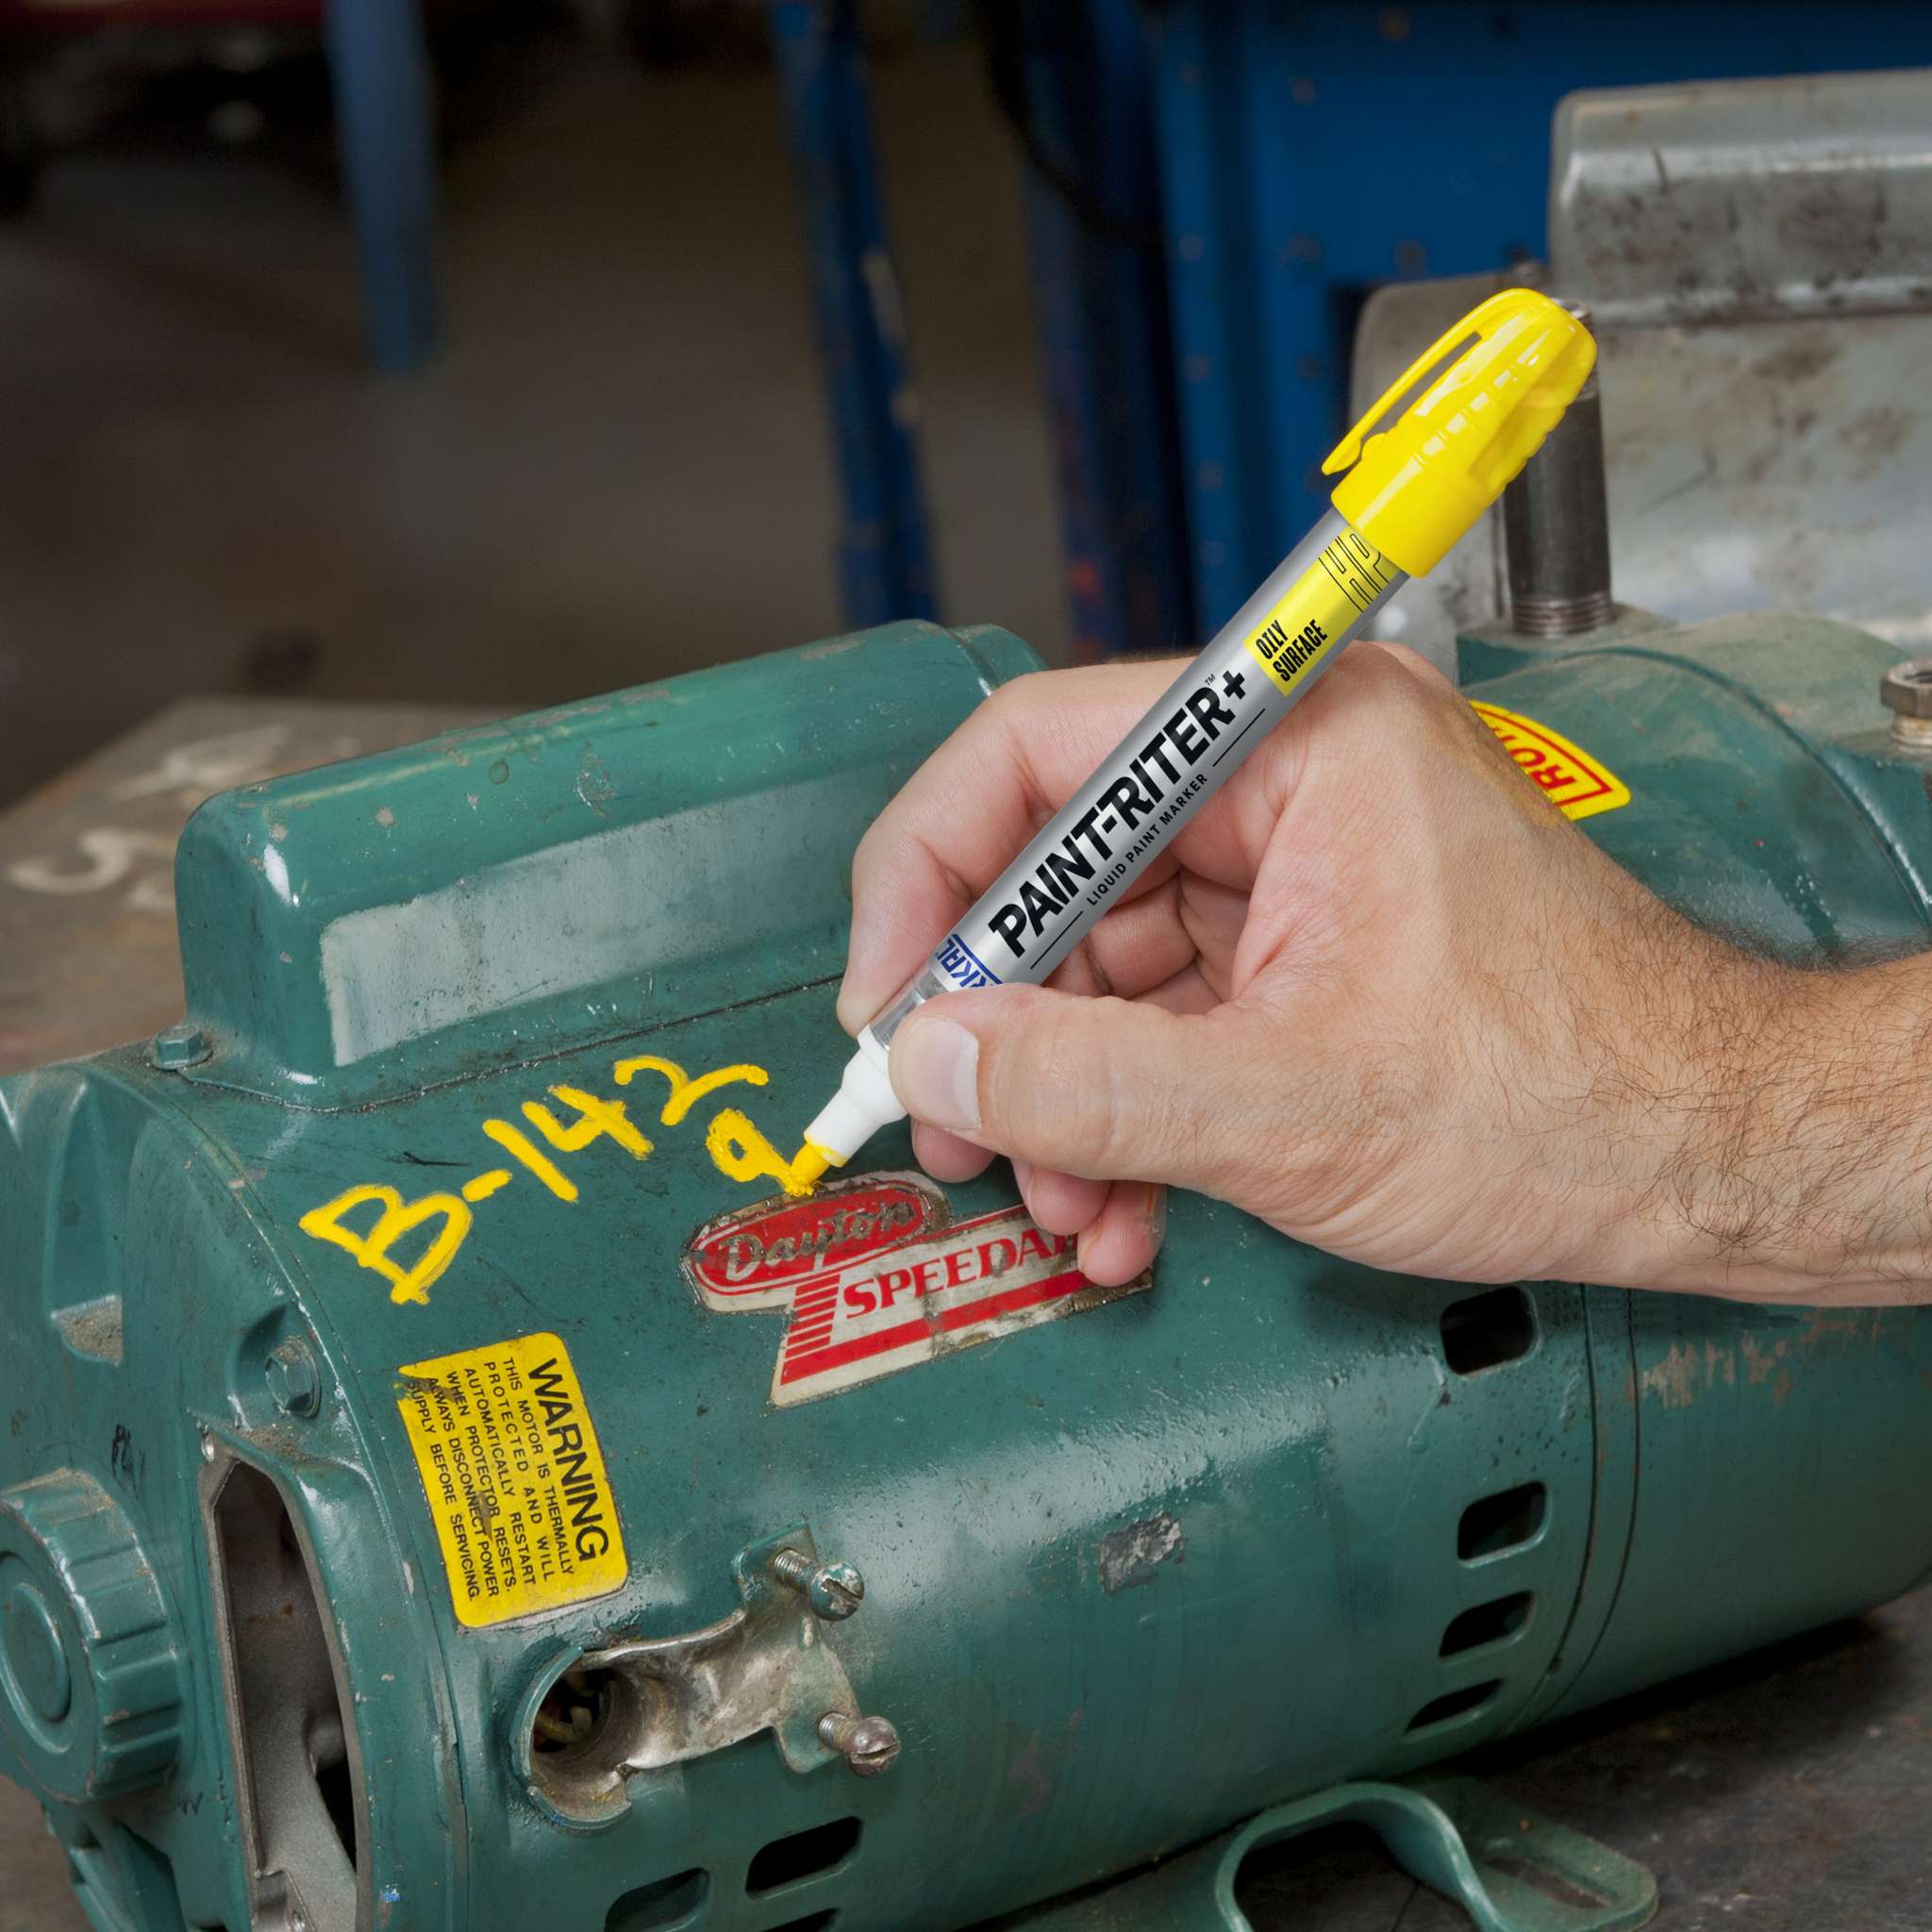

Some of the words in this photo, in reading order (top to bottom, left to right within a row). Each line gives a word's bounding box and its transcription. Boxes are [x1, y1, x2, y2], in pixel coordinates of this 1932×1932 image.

[1256, 620, 1289, 660] OILY
[1274, 619, 1328, 682] SURFACE
[1087, 862, 1127, 906] LIQUID
[1125, 826, 1161, 864] PAINT
[1159, 773, 1208, 826] MARKER
[299, 1055, 769, 1305] B-142
[718, 1200, 915, 1281] Dayton
[503, 1357, 523, 1391] THIS
[517, 1400, 543, 1455] MOTOR
[407, 1383, 437, 1434] SUPPLY
[430, 1443, 457, 1505] BEFORE
[450, 1513, 481, 1602] SERVICING.
[428, 1377, 456, 1432] ALWAYS
[448, 1438, 488, 1536] DISCONNECT
[477, 1541, 500, 1597] POWER
[446, 1371, 471, 1416] WHEN
[465, 1425, 501, 1517] PROTECTOR
[492, 1526, 517, 1592] RESETS.
[464, 1368, 516, 1497] AUTOMATICALLY
[509, 1511, 536, 1585] RESTART
[484, 1361, 528, 1473] PROTECTED
[523, 1487, 542, 1524] AND
[536, 1536, 555, 1582] WILL
[528, 1357, 609, 1562] WARNING
[536, 1463, 551, 1479] IS
[543, 1485, 575, 1574] THERMALLY
